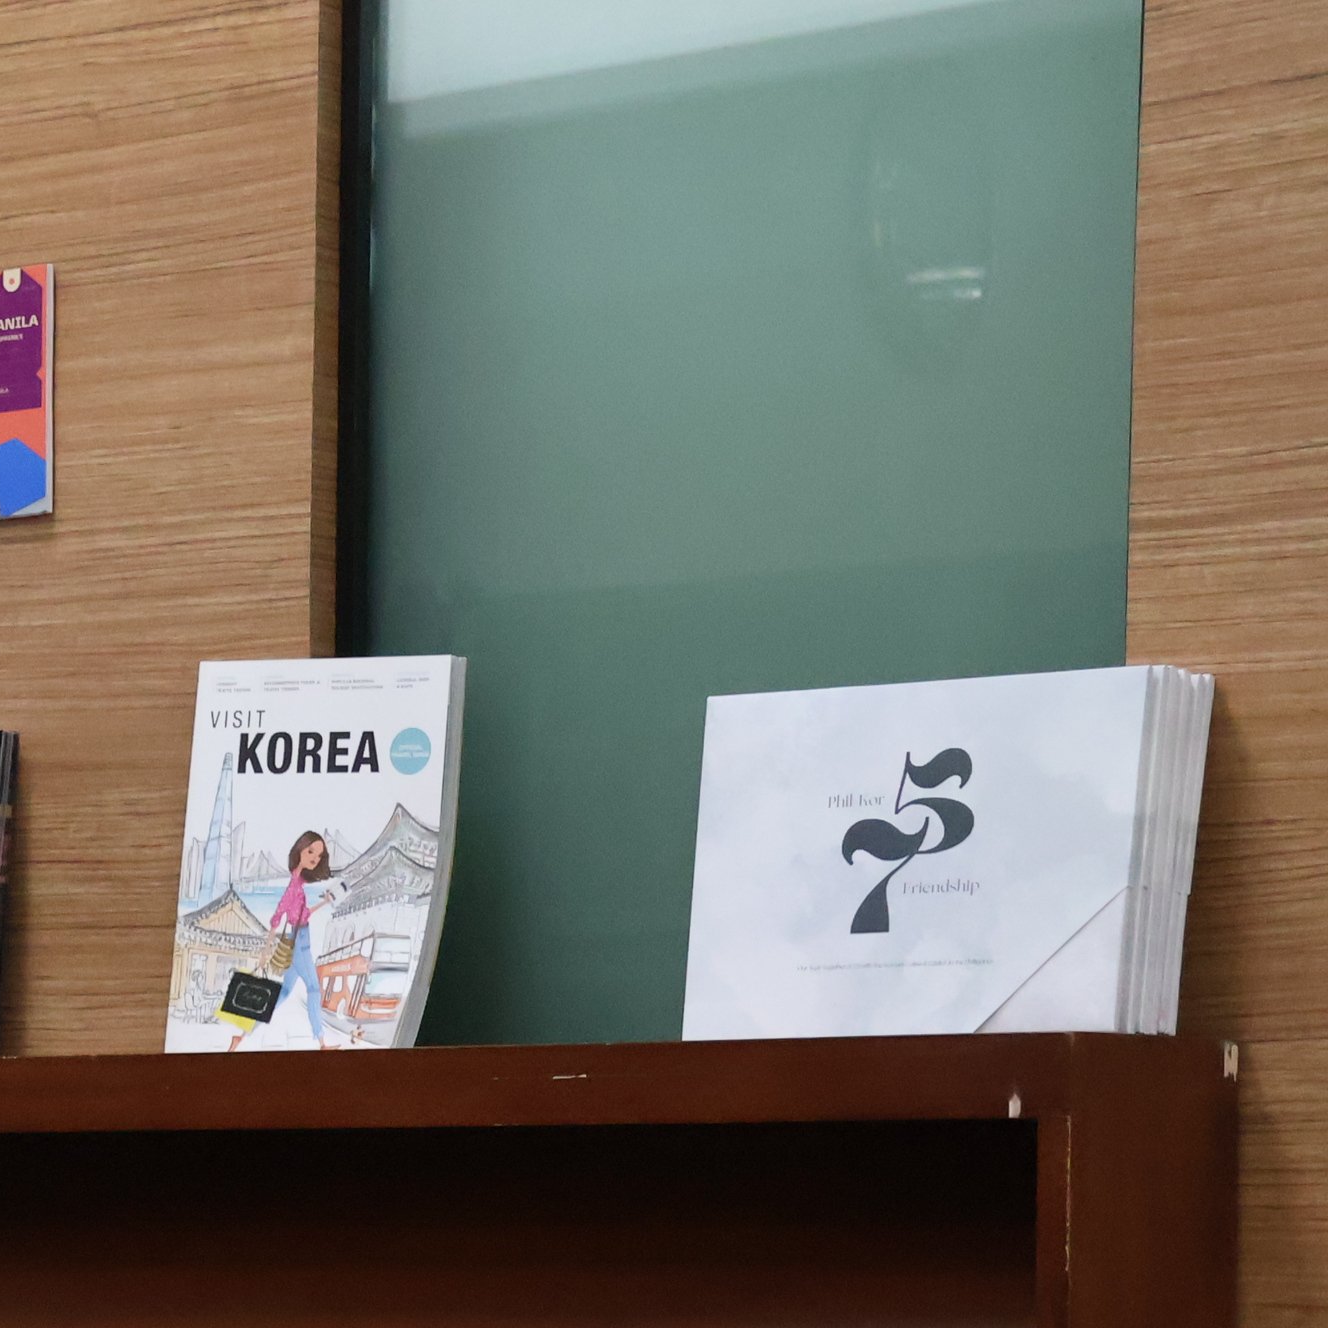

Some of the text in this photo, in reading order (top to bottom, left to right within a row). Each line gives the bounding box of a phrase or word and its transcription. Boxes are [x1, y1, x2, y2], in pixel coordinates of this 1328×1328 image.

[210, 709, 266, 729] VISIT
[237, 730, 380, 775] KOREA
[902, 879, 980, 897] Friendship
